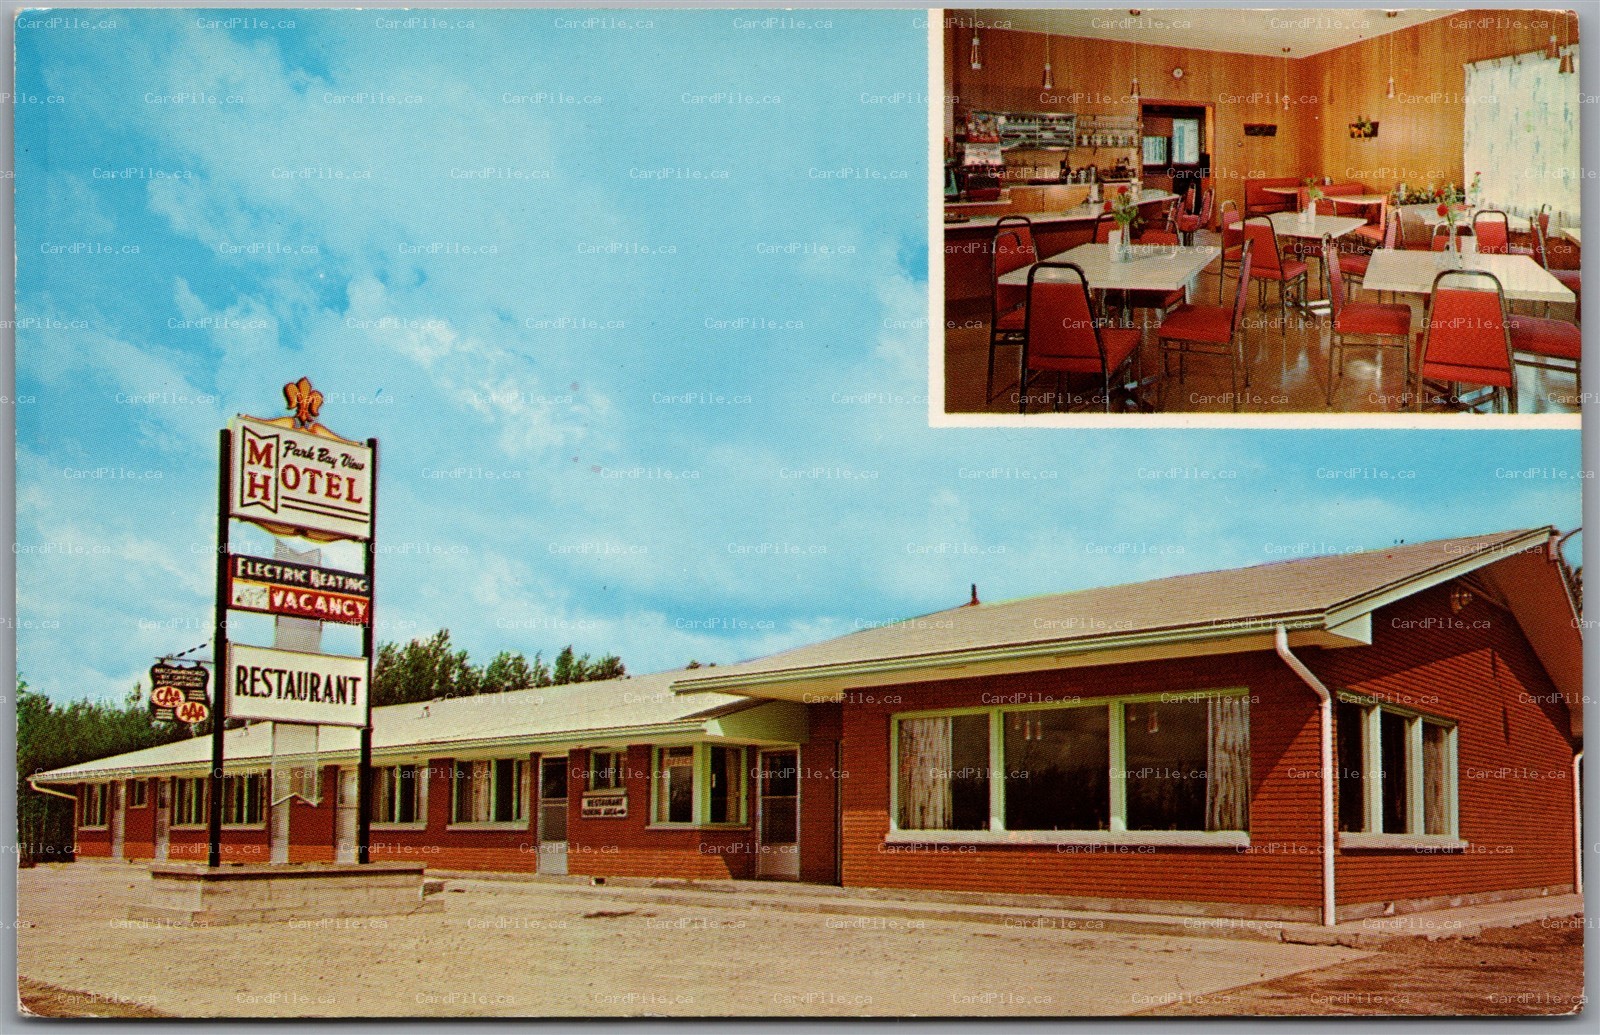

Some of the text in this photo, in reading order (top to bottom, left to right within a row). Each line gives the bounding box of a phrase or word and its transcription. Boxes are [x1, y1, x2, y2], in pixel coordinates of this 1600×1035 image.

[283, 439, 365, 471] Park Bay View
[237, 557, 308, 583] ELECTRIC
[272, 590, 367, 617] VACANCY
[235, 664, 362, 706] RESTAURANT
[181, 702, 206, 721] AAA
